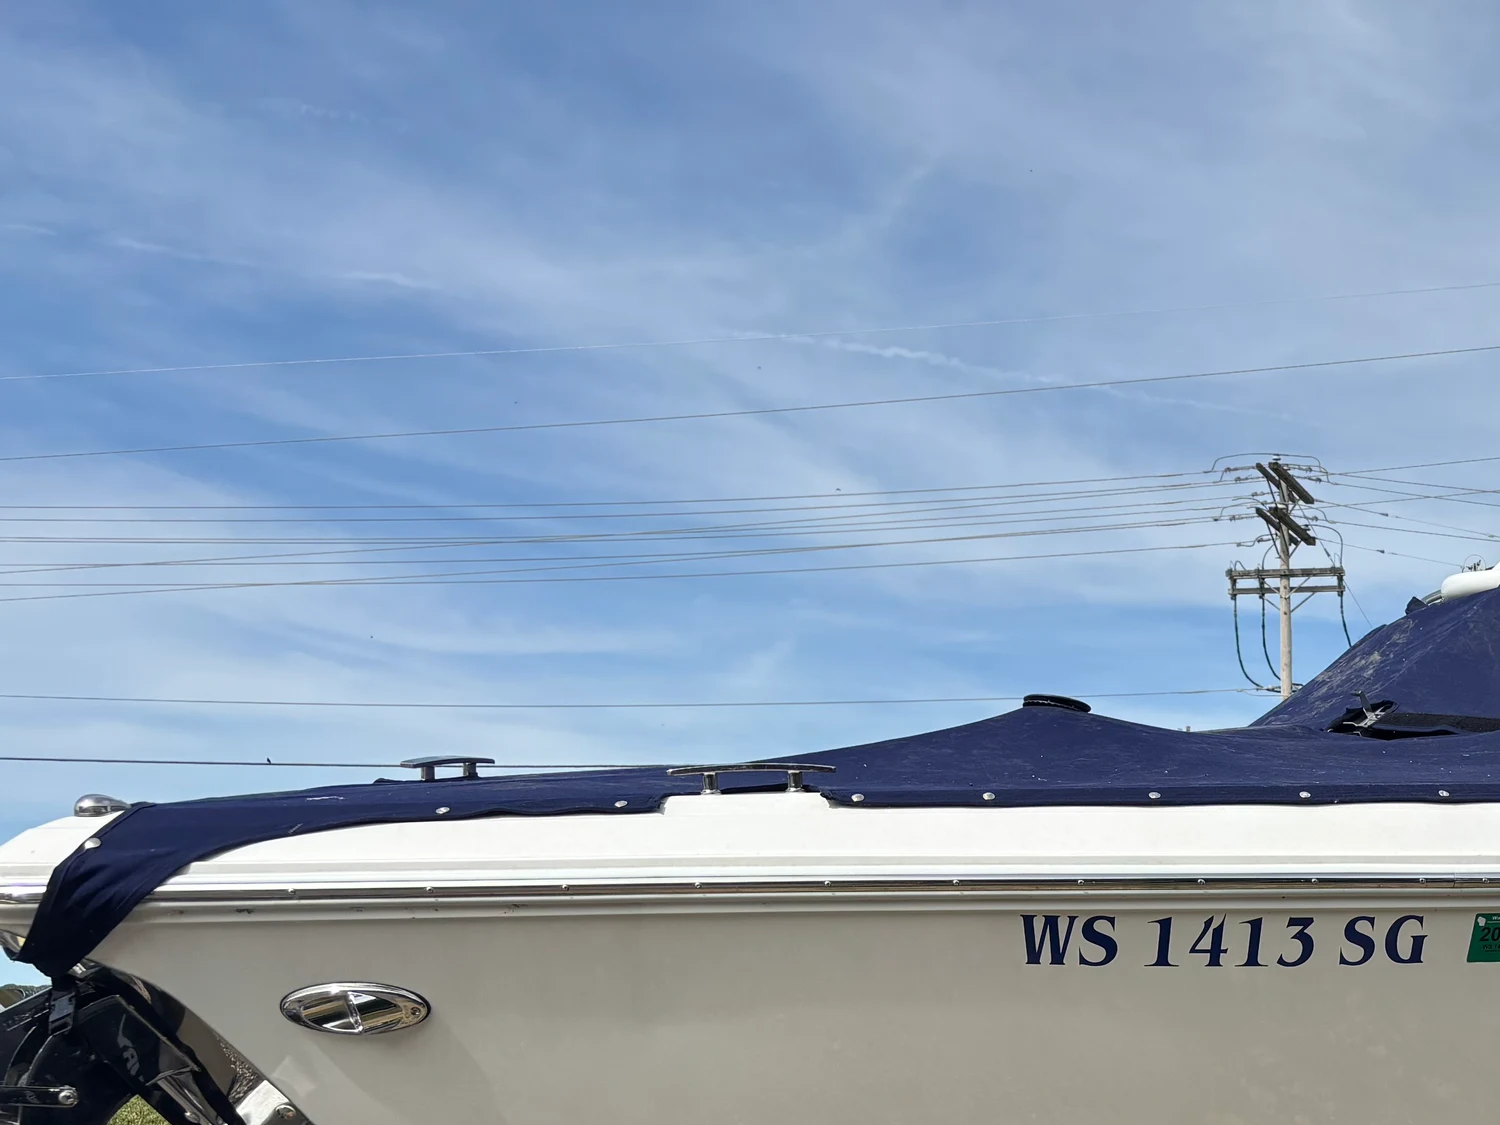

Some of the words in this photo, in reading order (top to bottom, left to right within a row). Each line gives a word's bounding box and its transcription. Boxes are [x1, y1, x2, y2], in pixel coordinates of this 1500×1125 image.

[1020, 914, 1119, 966] WS
[1143, 913, 1316, 968] 1413
[1338, 914, 1429, 966] SG
